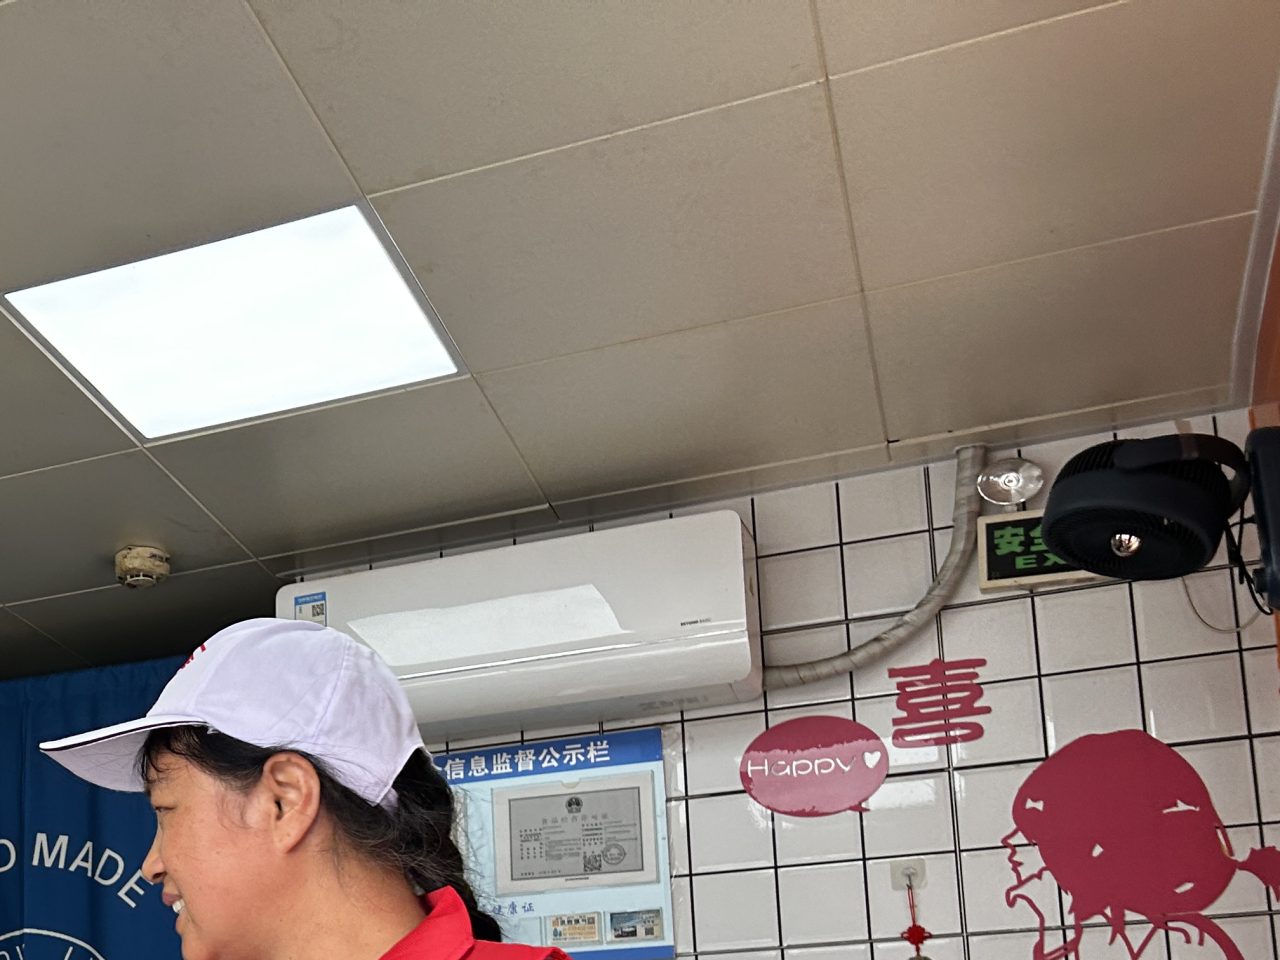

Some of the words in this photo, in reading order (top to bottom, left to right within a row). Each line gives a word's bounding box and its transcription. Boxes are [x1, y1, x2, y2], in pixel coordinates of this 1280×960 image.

[438, 740, 611, 780] 信息监督公示栏
[747, 756, 857, 778] Happy
[31, 832, 155, 909] MADE
